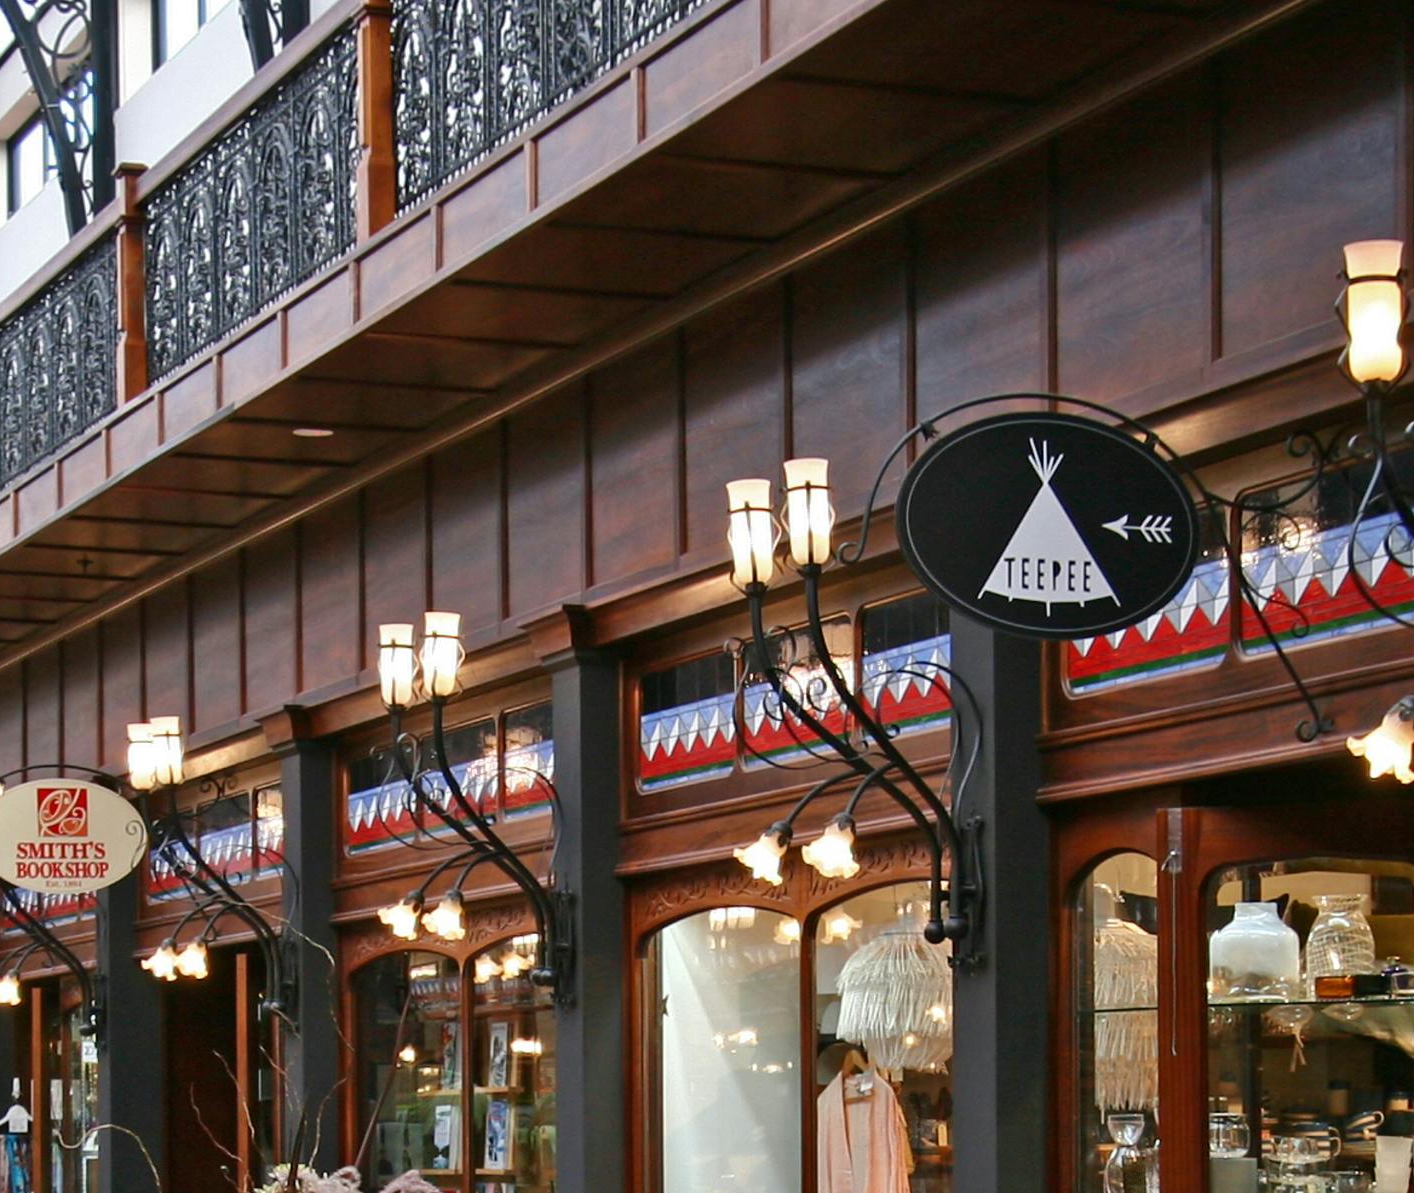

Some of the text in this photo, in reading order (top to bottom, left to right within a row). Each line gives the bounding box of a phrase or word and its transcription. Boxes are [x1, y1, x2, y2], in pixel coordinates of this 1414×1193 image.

[1003, 556, 1093, 593] TEEPEE
[15, 841, 106, 860] SMITH'S
[15, 861, 110, 879] BOOKSHOP
